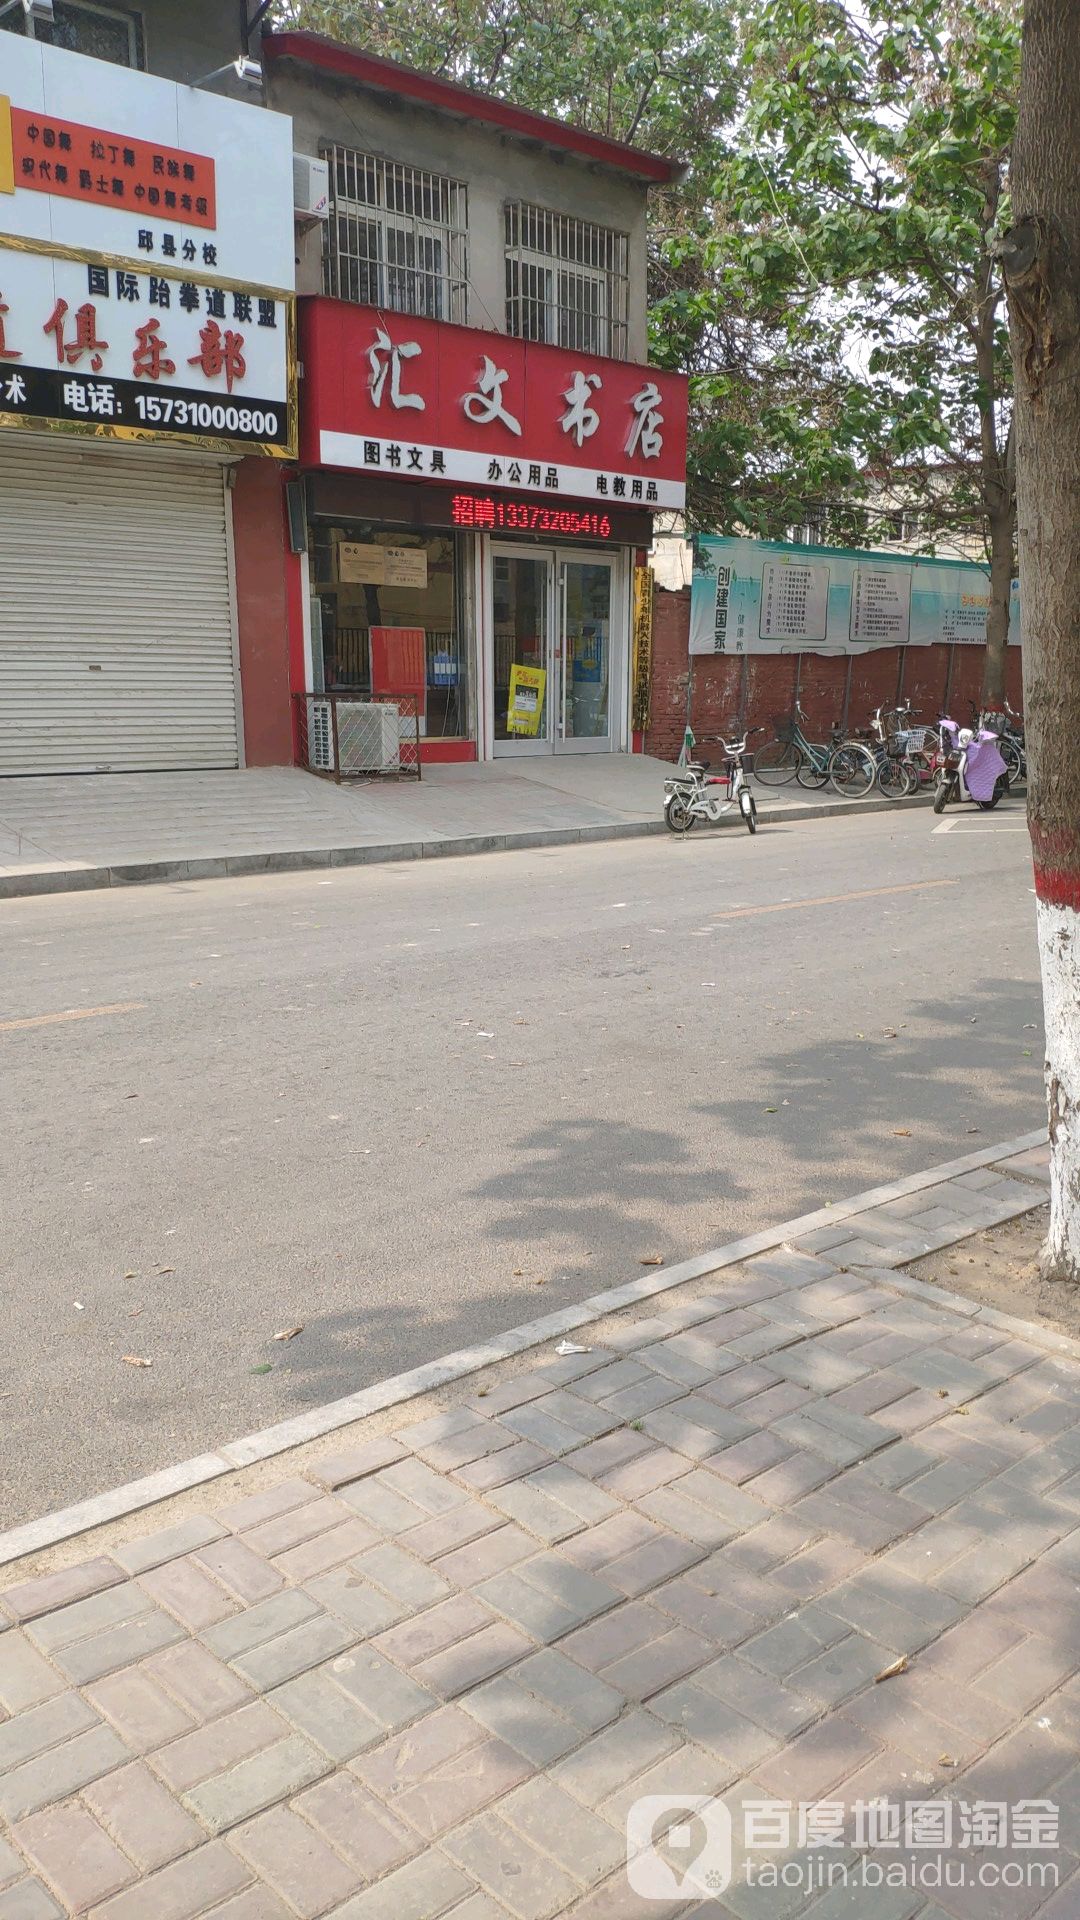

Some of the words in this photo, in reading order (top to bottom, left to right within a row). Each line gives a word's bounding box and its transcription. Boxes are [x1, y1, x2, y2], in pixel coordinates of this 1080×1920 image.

[27, 123, 71, 151] 中国舞
[91, 139, 136, 169] 拉丁舞
[152, 155, 195, 182] 民族舞
[22, 157, 68, 184] 现代舞
[79, 168, 125, 196] 爵士舞
[134, 182, 208, 216] 中国舞考级
[138, 229, 217, 266] 邱县分校
[87, 263, 277, 328] 国际跆拳道联盟
[0, 374, 27, 405] 术
[367, 328, 664, 459] 汇文书店
[363, 440, 447, 473] 图书文具
[488, 458, 559, 489] 办公用品
[597, 475, 658, 501] 电教用品
[714, 566, 730, 654] 创建国家
